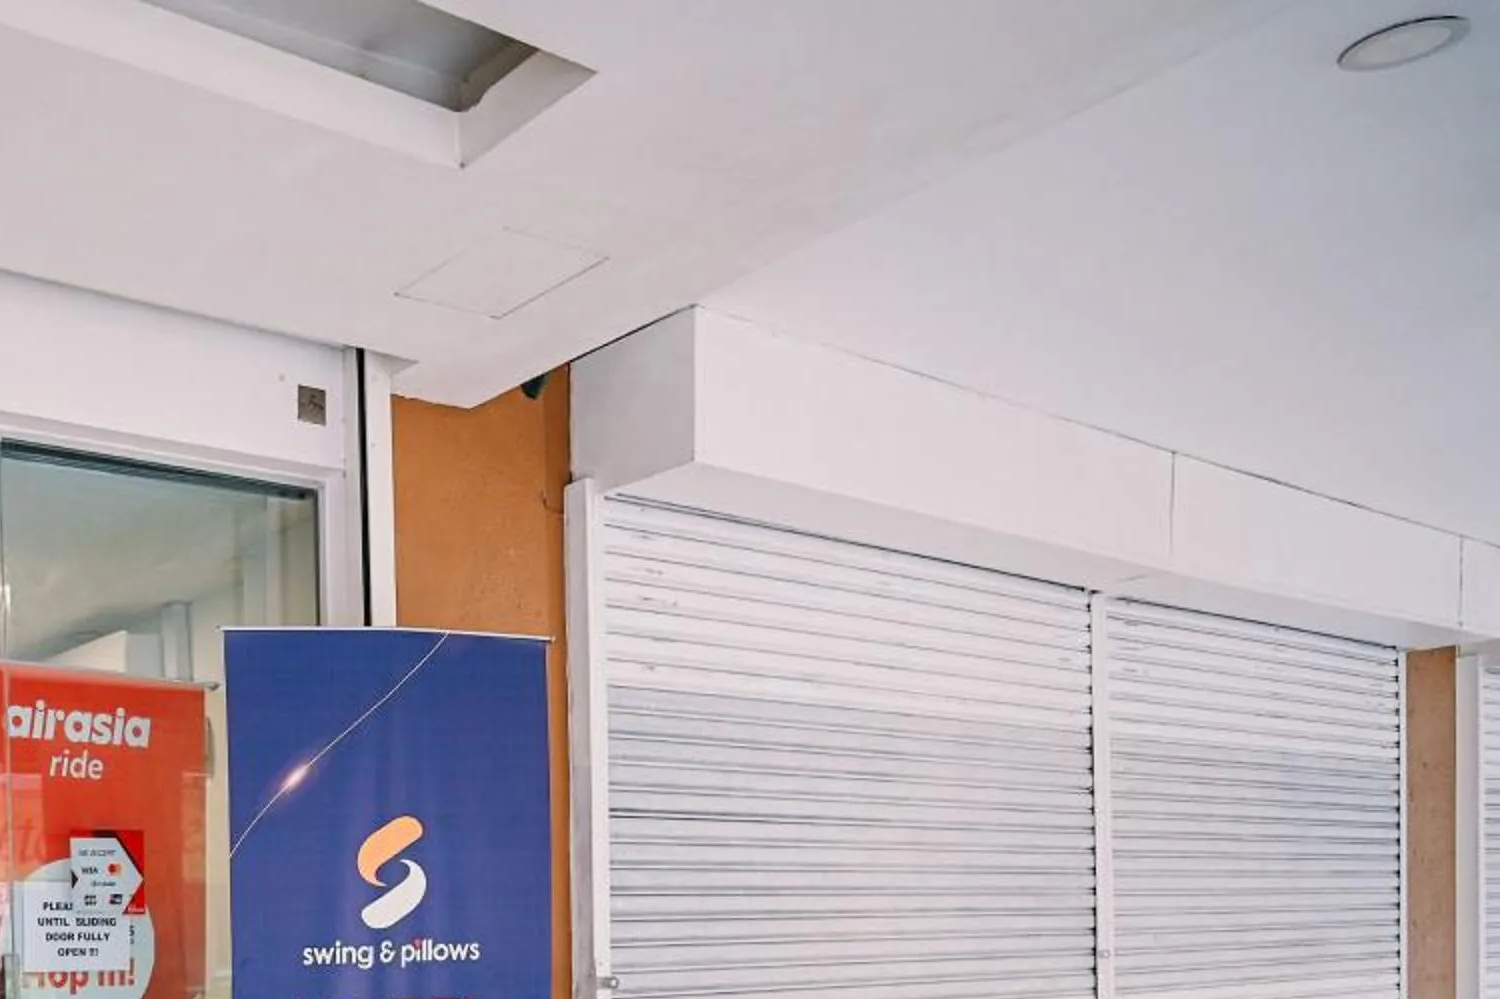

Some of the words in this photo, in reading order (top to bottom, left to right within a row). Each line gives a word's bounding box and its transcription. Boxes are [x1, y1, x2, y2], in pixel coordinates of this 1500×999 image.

[7, 700, 150, 748] airasia
[49, 750, 104, 780] ride
[37, 917, 71, 927] UNTIL
[75, 917, 117, 927] SLIDING
[45, 932, 75, 942] DOOR
[77, 932, 111, 942] FULLY
[57, 947, 87, 957] OPEN
[303, 940, 374, 970] swing
[380, 940, 396, 964] &
[401, 938, 480, 968] pillows
